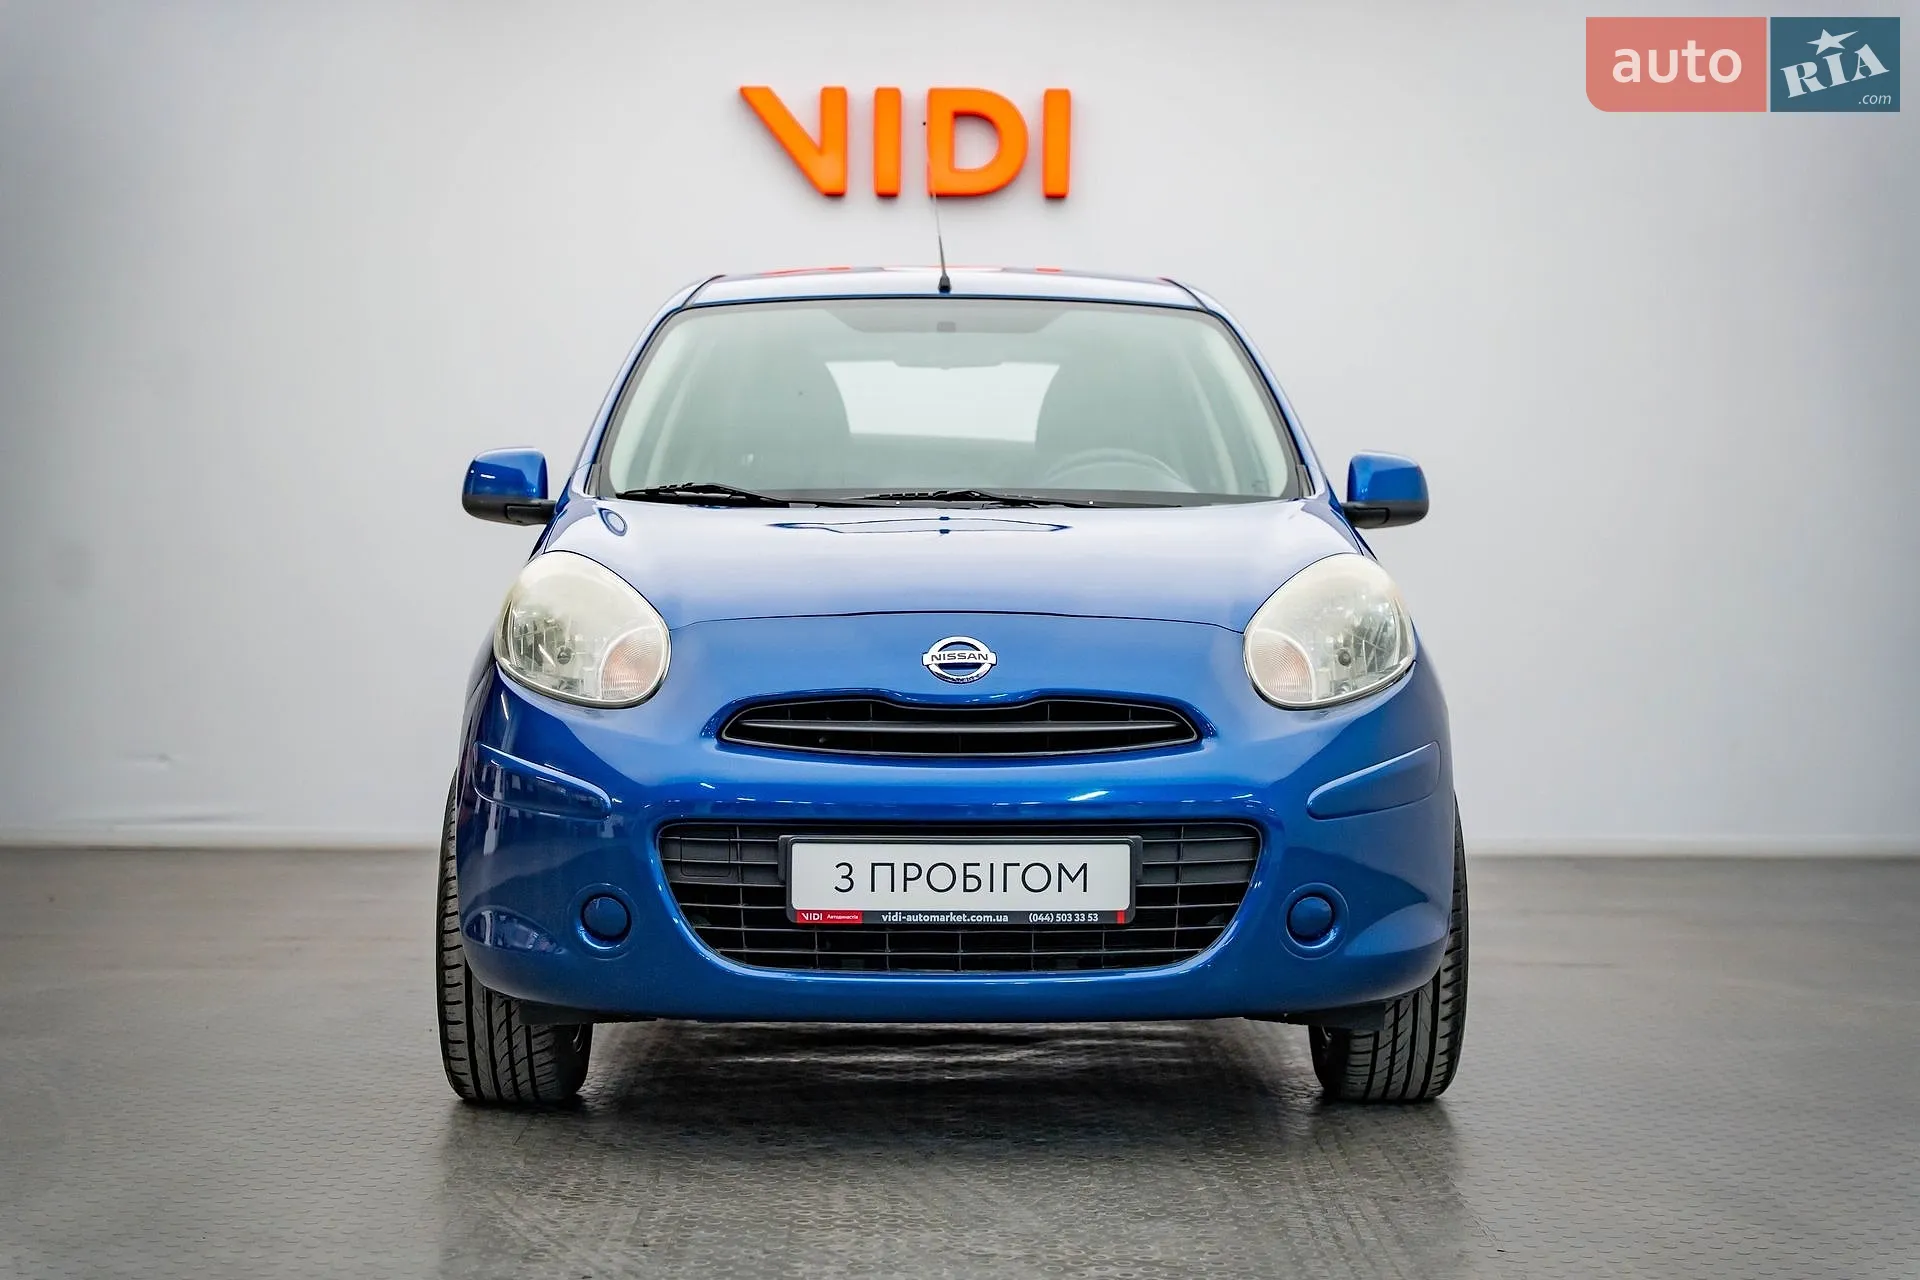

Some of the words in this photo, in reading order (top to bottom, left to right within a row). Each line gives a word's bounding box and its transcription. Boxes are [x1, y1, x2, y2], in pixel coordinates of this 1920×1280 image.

[739, 85, 1072, 198] VIDI
[931, 652, 989, 661] NISSAN
[870, 862, 1089, 893] ПРОБІГОМ
[801, 912, 823, 921] VIDI
[881, 912, 1009, 922] vidi-automarket.com.ua
[1028, 912, 1054, 923] (044)
[1056, 912, 1073, 922] 503
[1074, 912, 1086, 922] 33
[1087, 912, 1099, 922] 53
